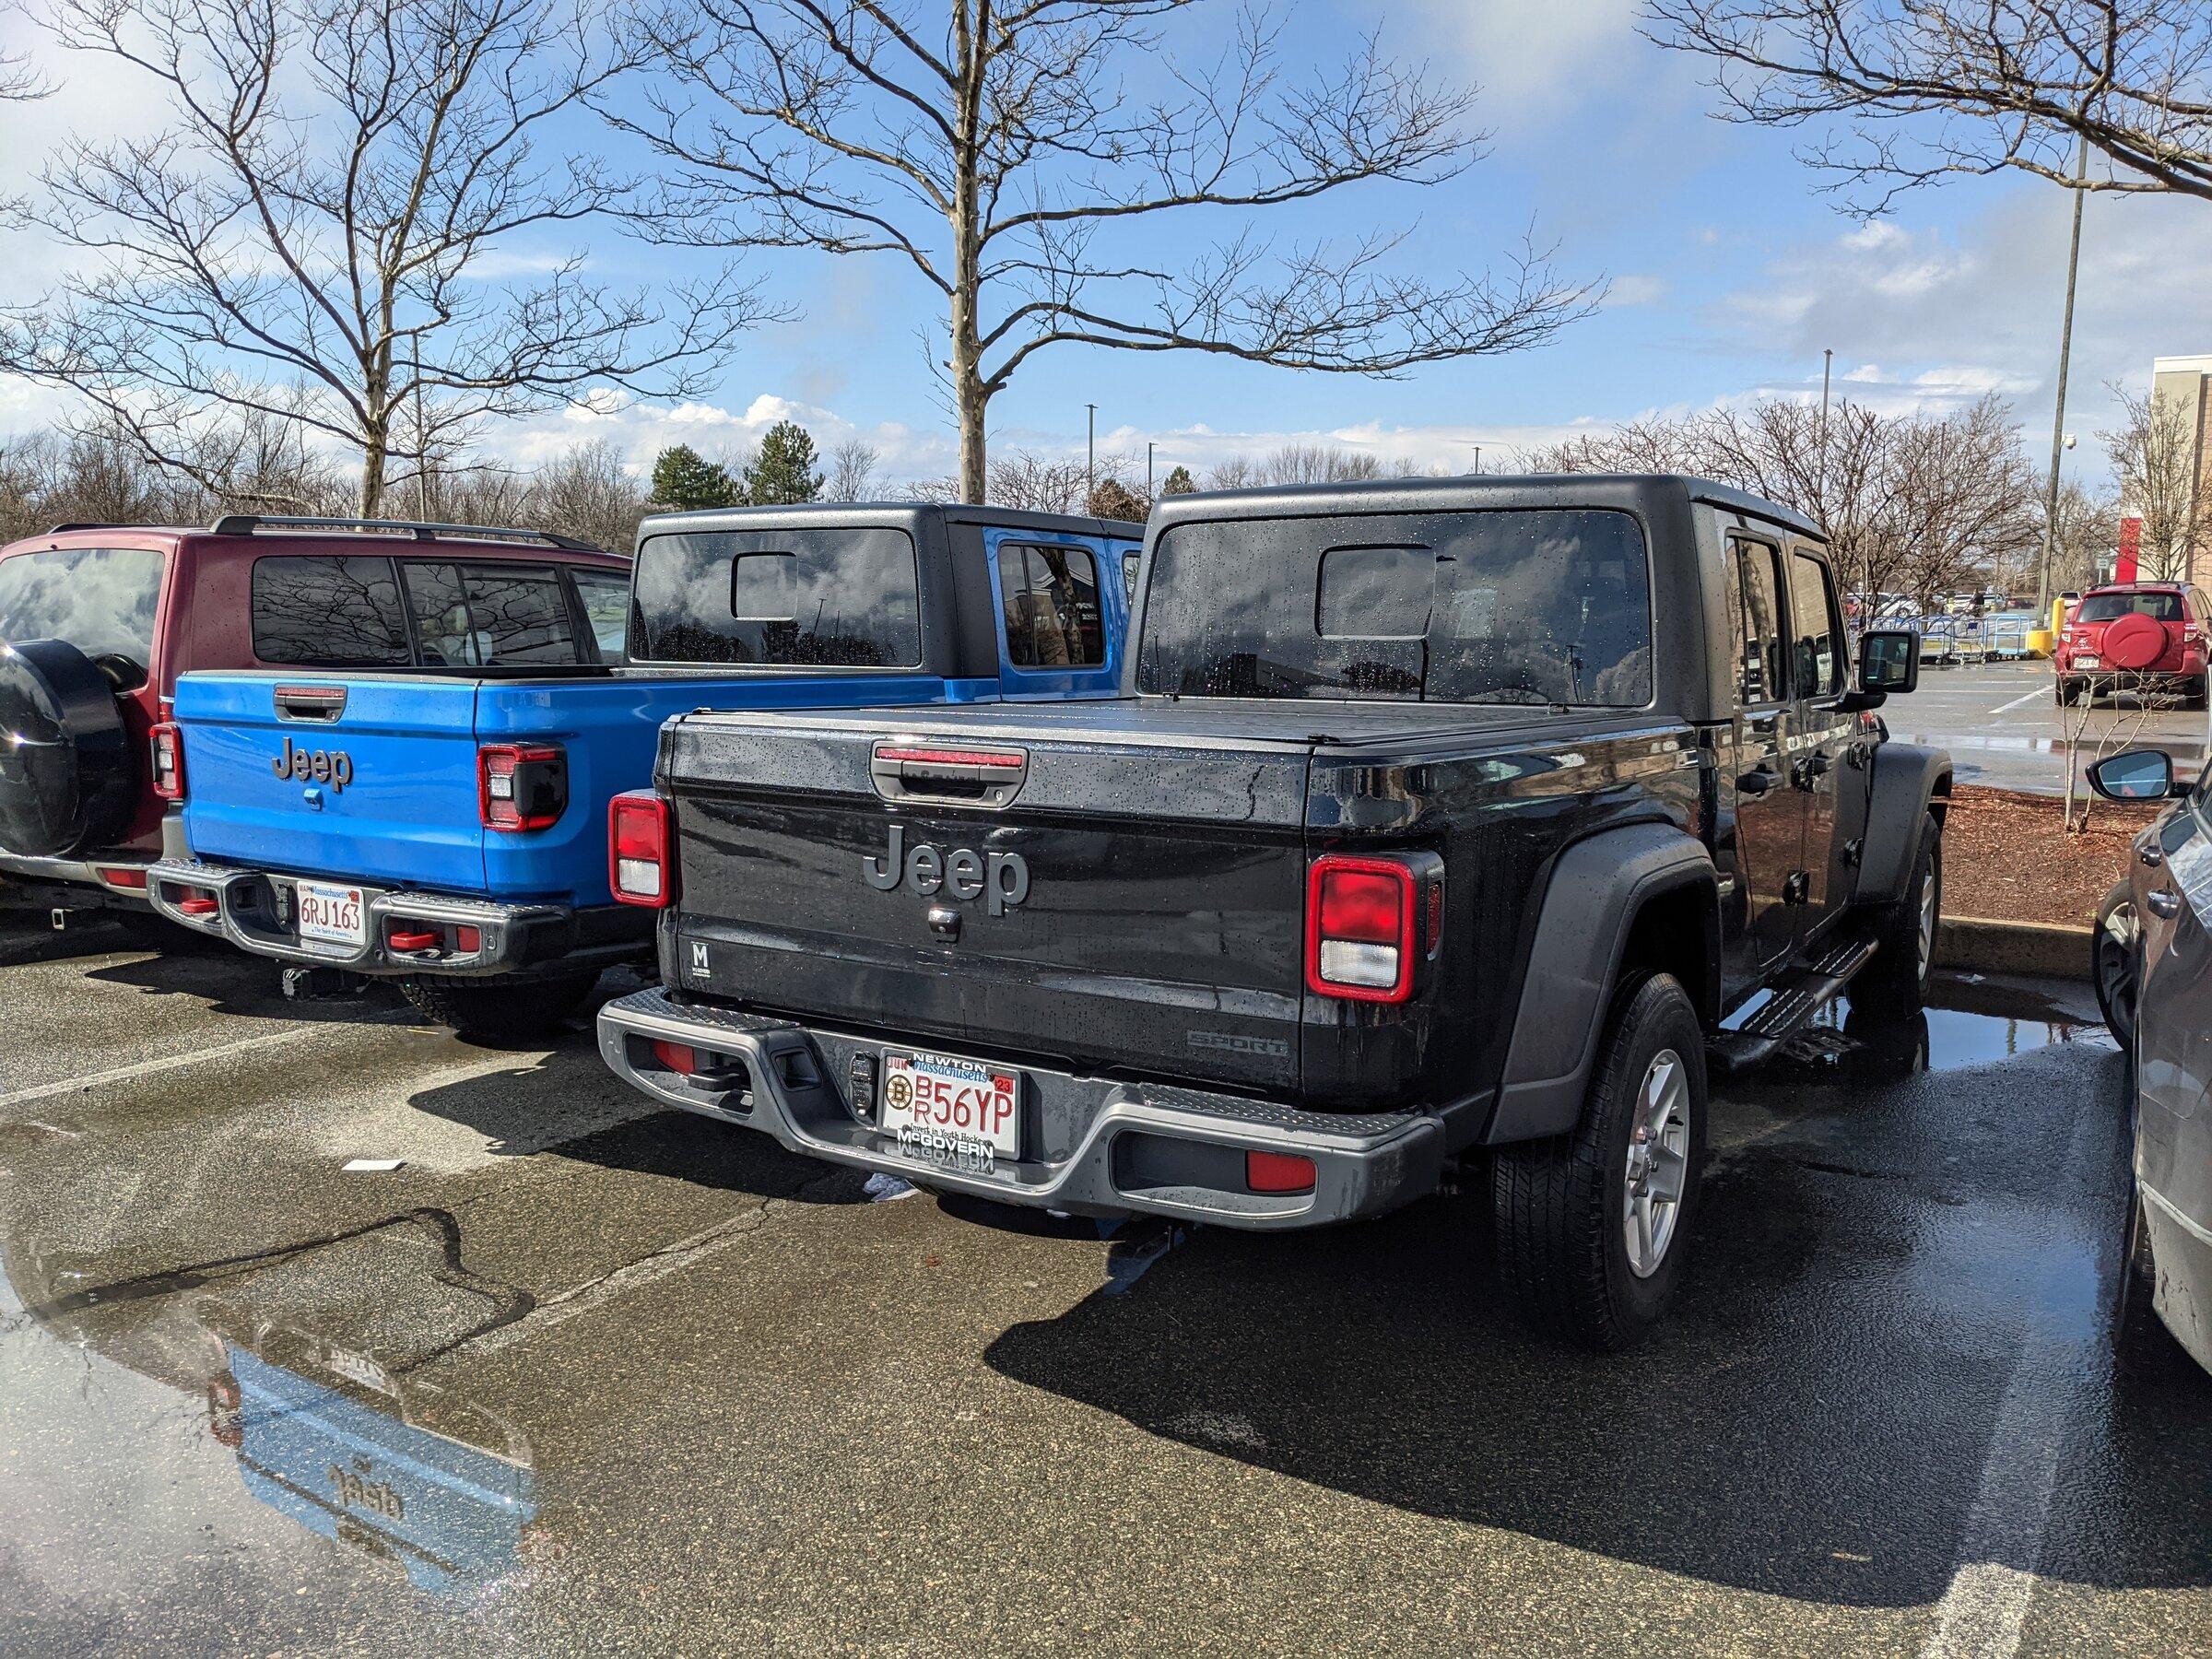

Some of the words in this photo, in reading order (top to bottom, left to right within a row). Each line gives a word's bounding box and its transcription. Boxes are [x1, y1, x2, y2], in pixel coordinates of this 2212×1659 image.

[272, 736, 354, 794] Jeep
[863, 825, 1030, 916] Jeep
[301, 897, 329, 926] 6RJ
[332, 900, 359, 931] 163
[692, 943, 709, 968] M
[1186, 1030, 1288, 1056] SPORT
[887, 1056, 909, 1071] JUN
[912, 1053, 987, 1073] NEWTON
[913, 1060, 989, 1083] Massachusetts
[897, 1129, 994, 1159] McGOVERN
[910, 1123, 931, 1135] Invest
[932, 1127, 939, 1135] in
[940, 1129, 959, 1140] Youth
[960, 1132, 983, 1143] Hocke
